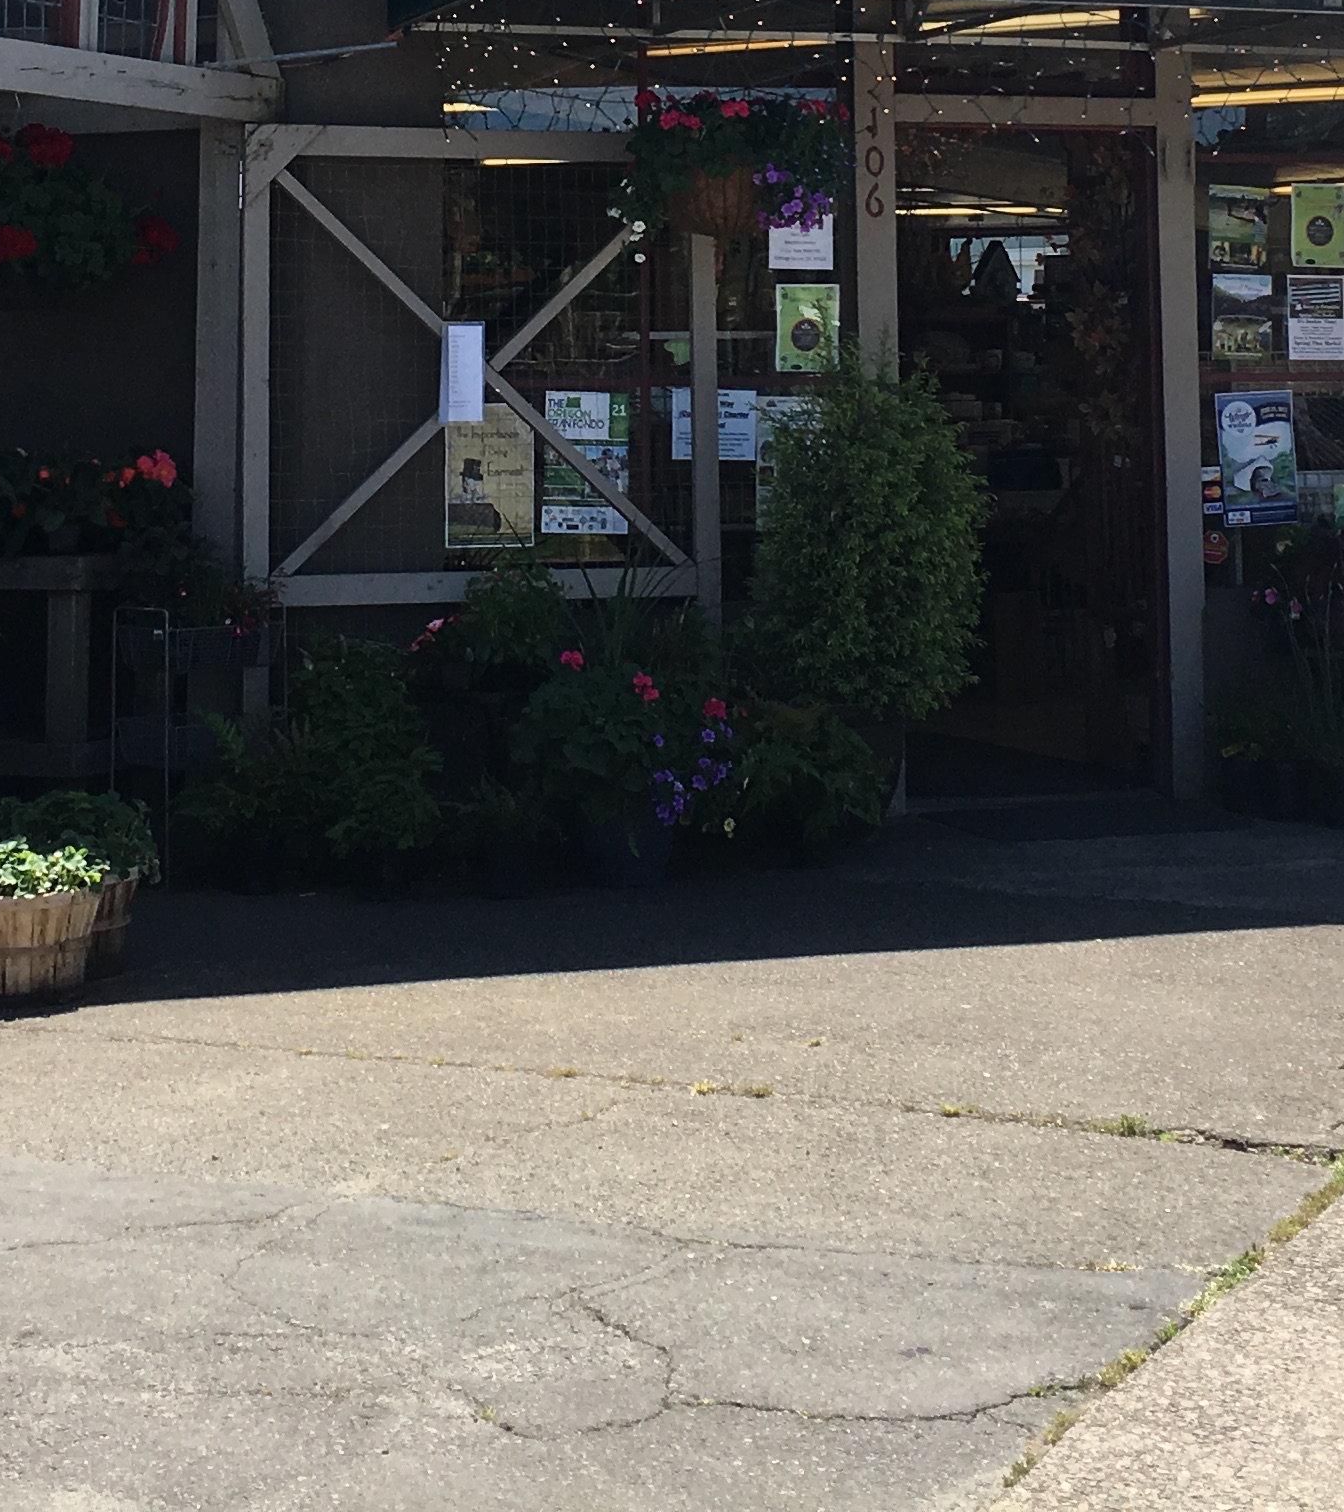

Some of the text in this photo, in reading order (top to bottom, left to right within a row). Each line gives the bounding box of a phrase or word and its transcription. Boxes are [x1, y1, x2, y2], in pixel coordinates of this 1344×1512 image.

[864, 106, 885, 219] 106
[548, 399, 564, 409] THE
[612, 404, 627, 417] 21
[1206, 504, 1223, 513] VISA
